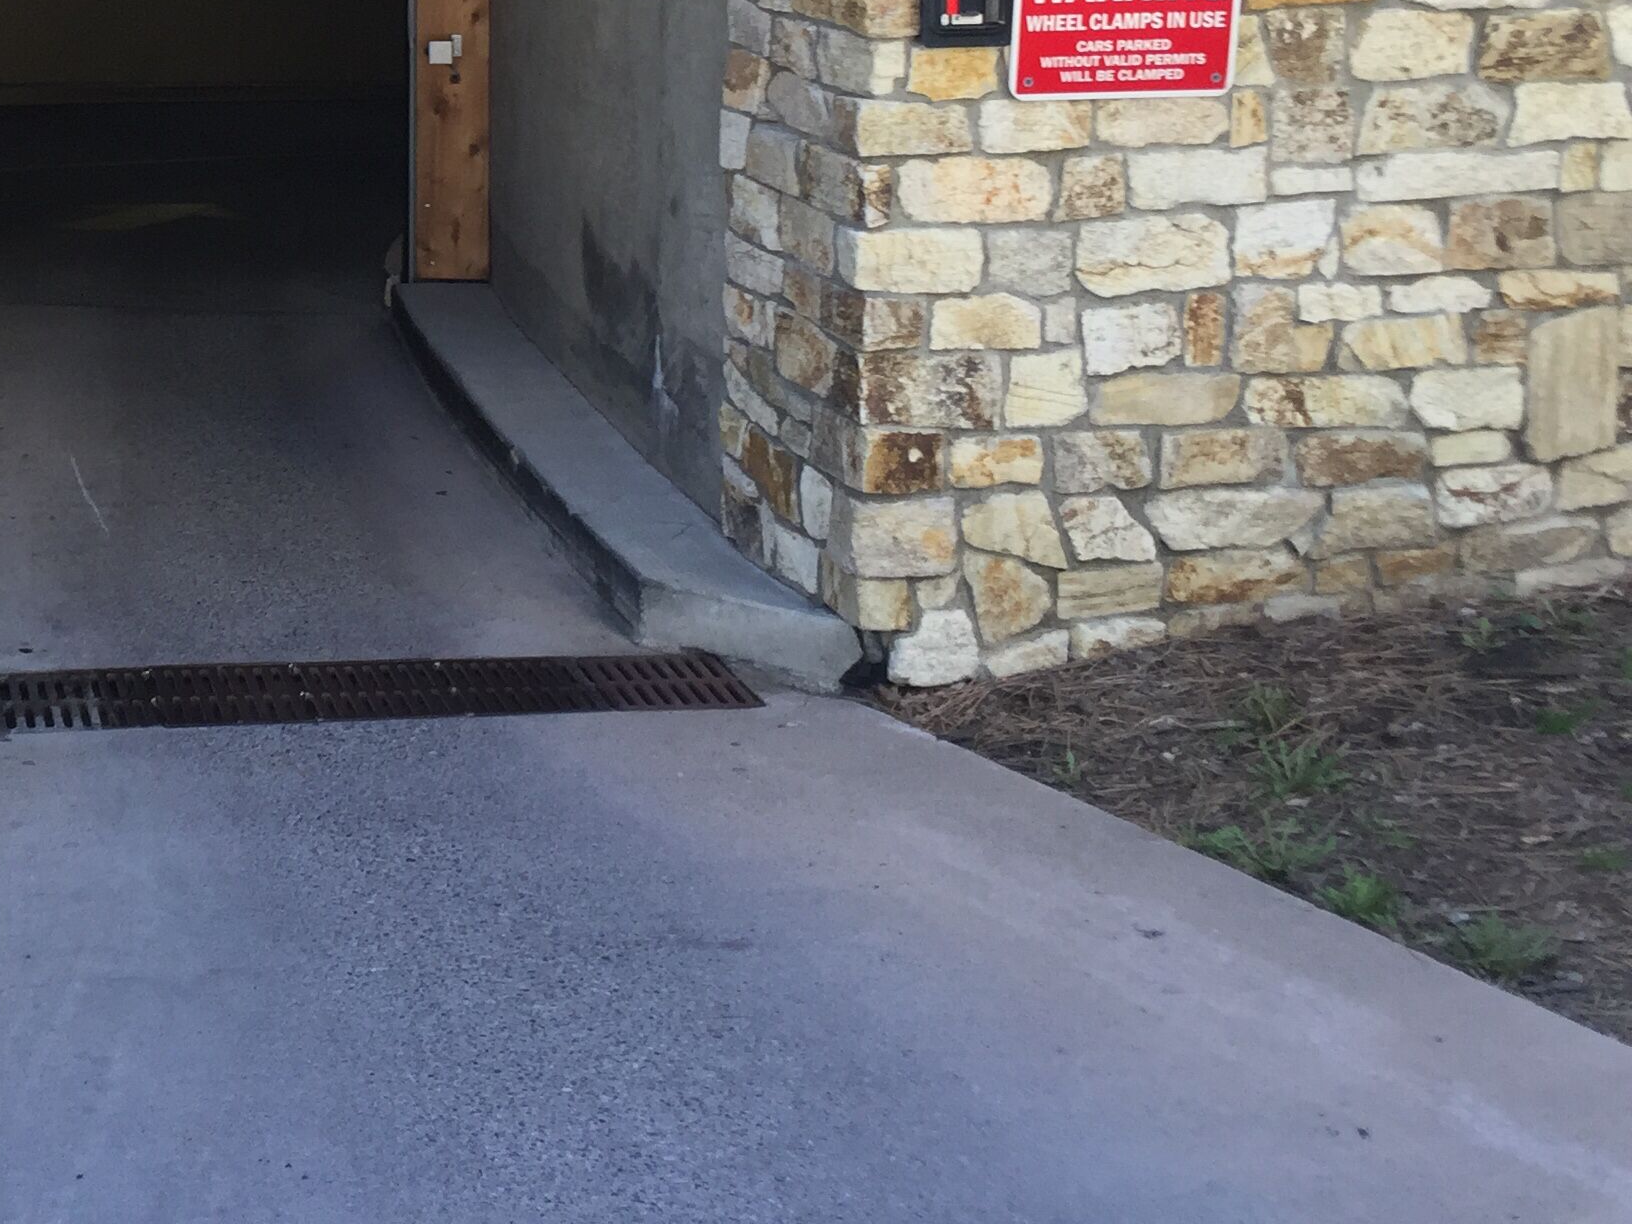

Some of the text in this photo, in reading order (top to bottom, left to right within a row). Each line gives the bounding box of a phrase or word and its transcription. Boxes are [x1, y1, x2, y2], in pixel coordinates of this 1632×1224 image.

[1026, 11, 1227, 33] WHEEL CLAMPS IN USE
[1076, 38, 1172, 53] CARS PARKED
[1040, 53, 1207, 69] WITHOUT VALID PERMITS
[1060, 68, 1185, 83] WILL BE CLAMPED
